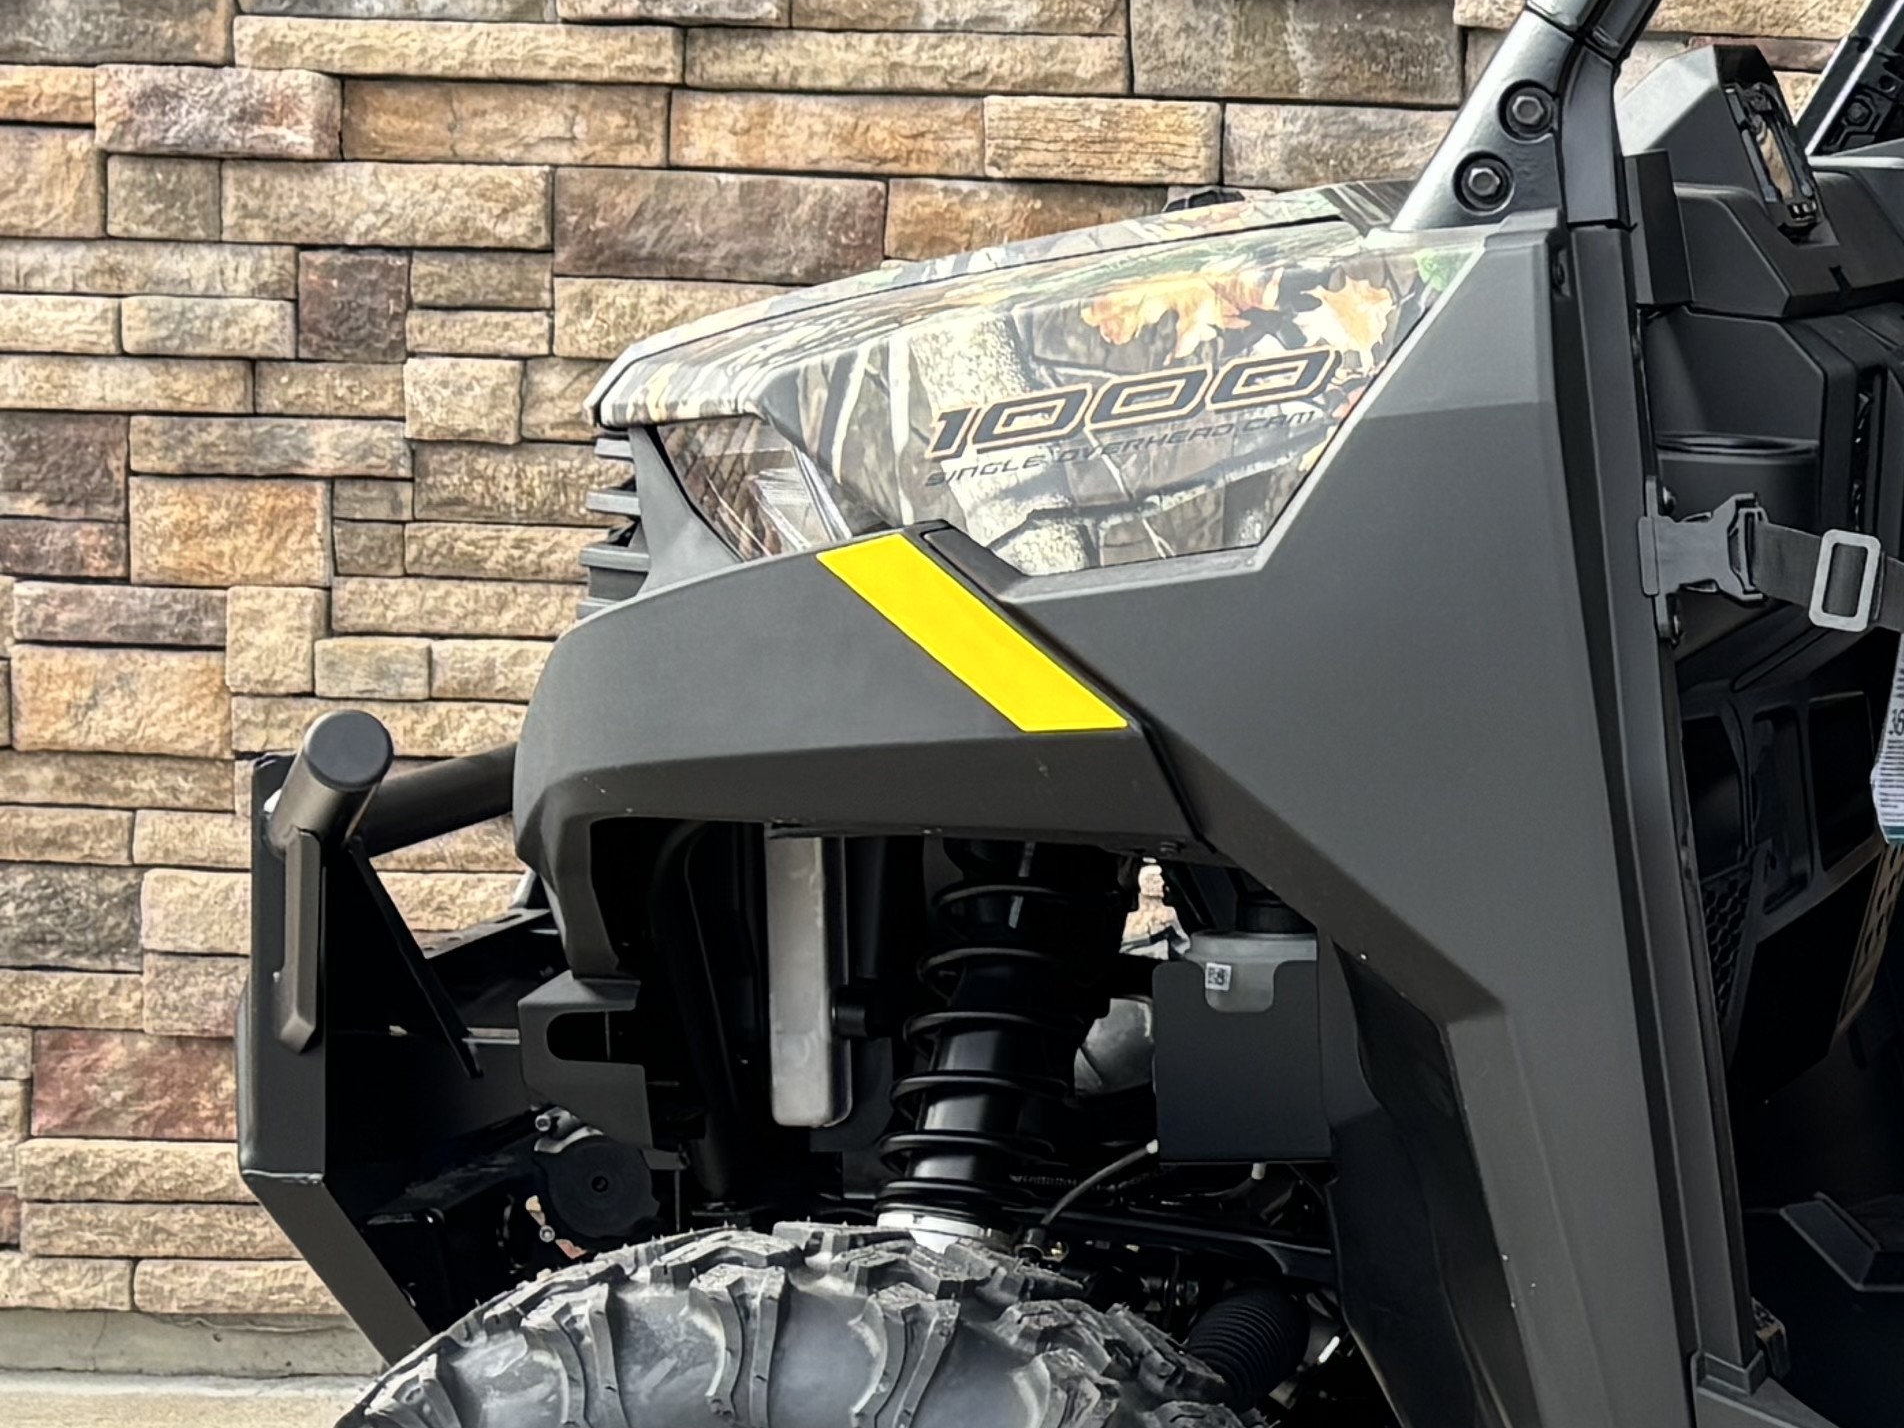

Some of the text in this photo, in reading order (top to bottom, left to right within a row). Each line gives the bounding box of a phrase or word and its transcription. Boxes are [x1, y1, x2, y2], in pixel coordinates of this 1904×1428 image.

[924, 347, 1341, 462] 1000
[925, 409, 1317, 488] SINGLE OVERHEAD CAM
